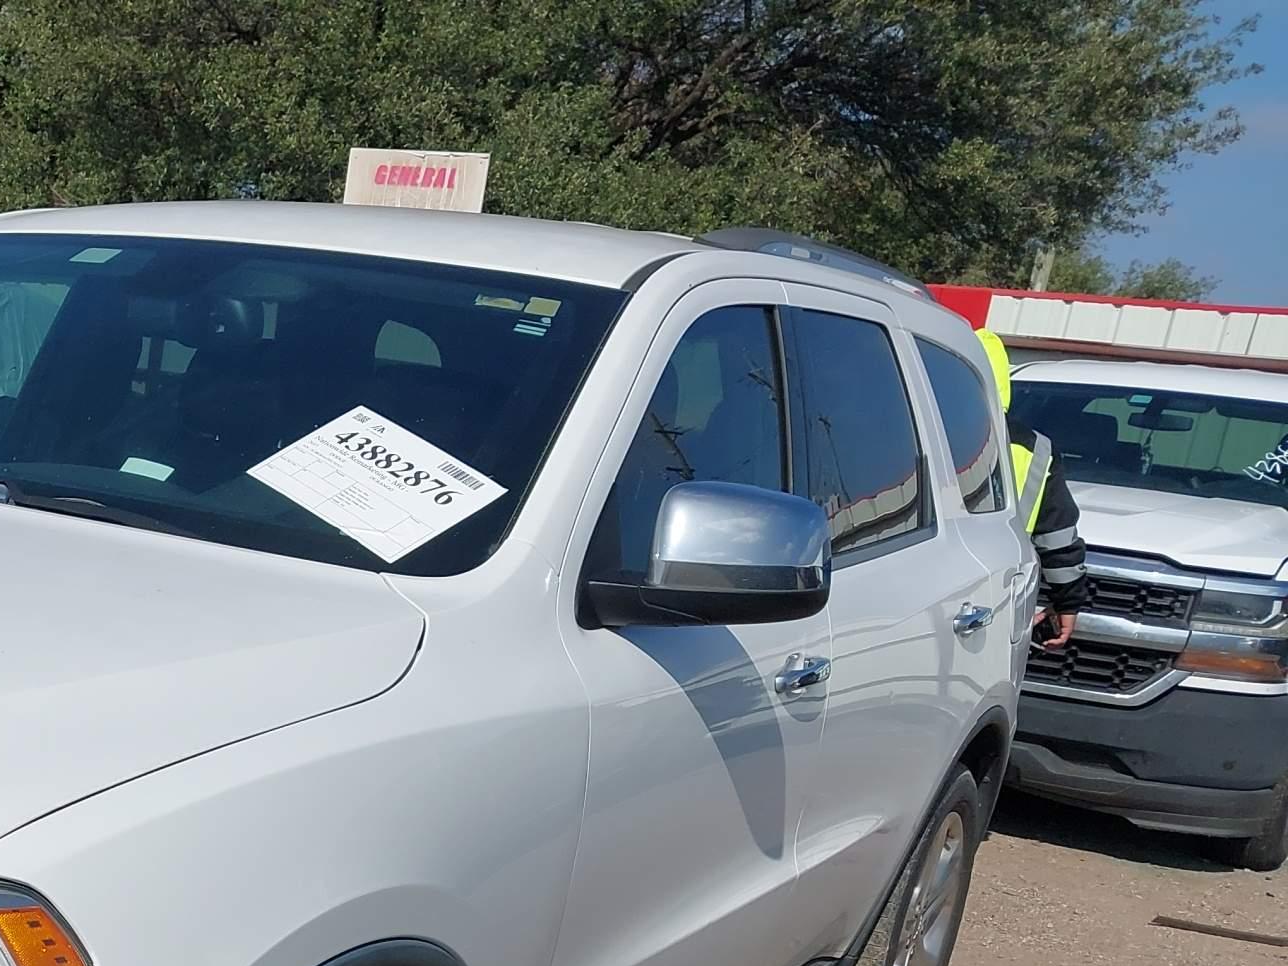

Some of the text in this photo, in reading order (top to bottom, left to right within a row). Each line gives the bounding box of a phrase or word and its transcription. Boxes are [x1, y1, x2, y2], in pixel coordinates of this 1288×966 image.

[374, 165, 456, 189] GENERAL
[334, 431, 465, 507] 43882876
[349, 454, 388, 480] Remarketing
